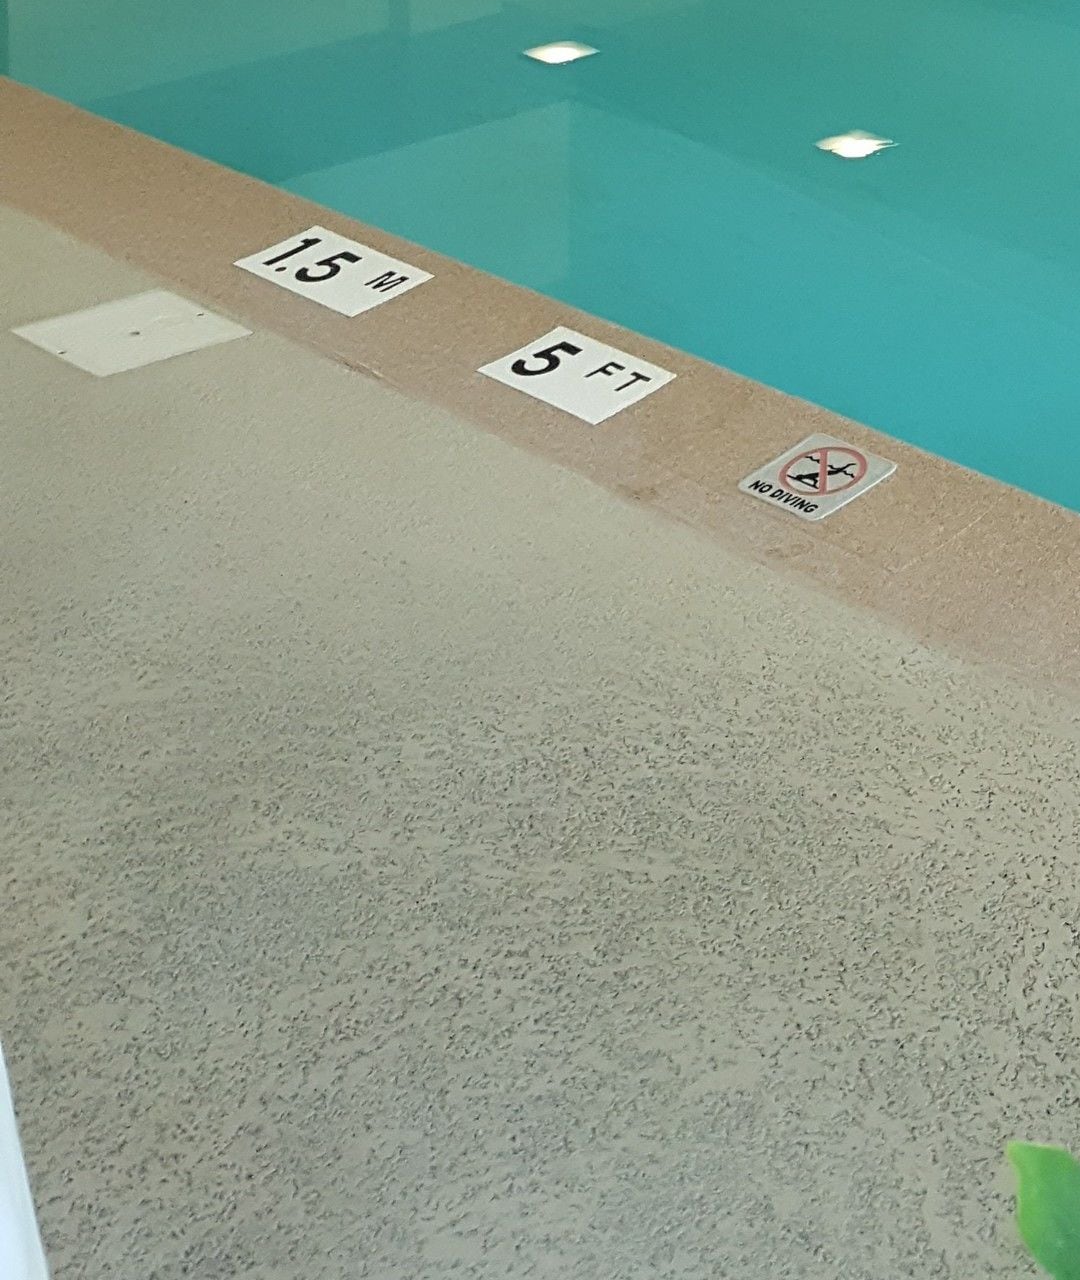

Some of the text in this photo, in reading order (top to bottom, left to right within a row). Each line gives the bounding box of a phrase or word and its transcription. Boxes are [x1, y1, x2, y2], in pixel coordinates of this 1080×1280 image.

[262, 238, 409, 292] 1.5 M
[511, 341, 651, 391] 5 FT
[748, 480, 818, 513] NO DIVING
